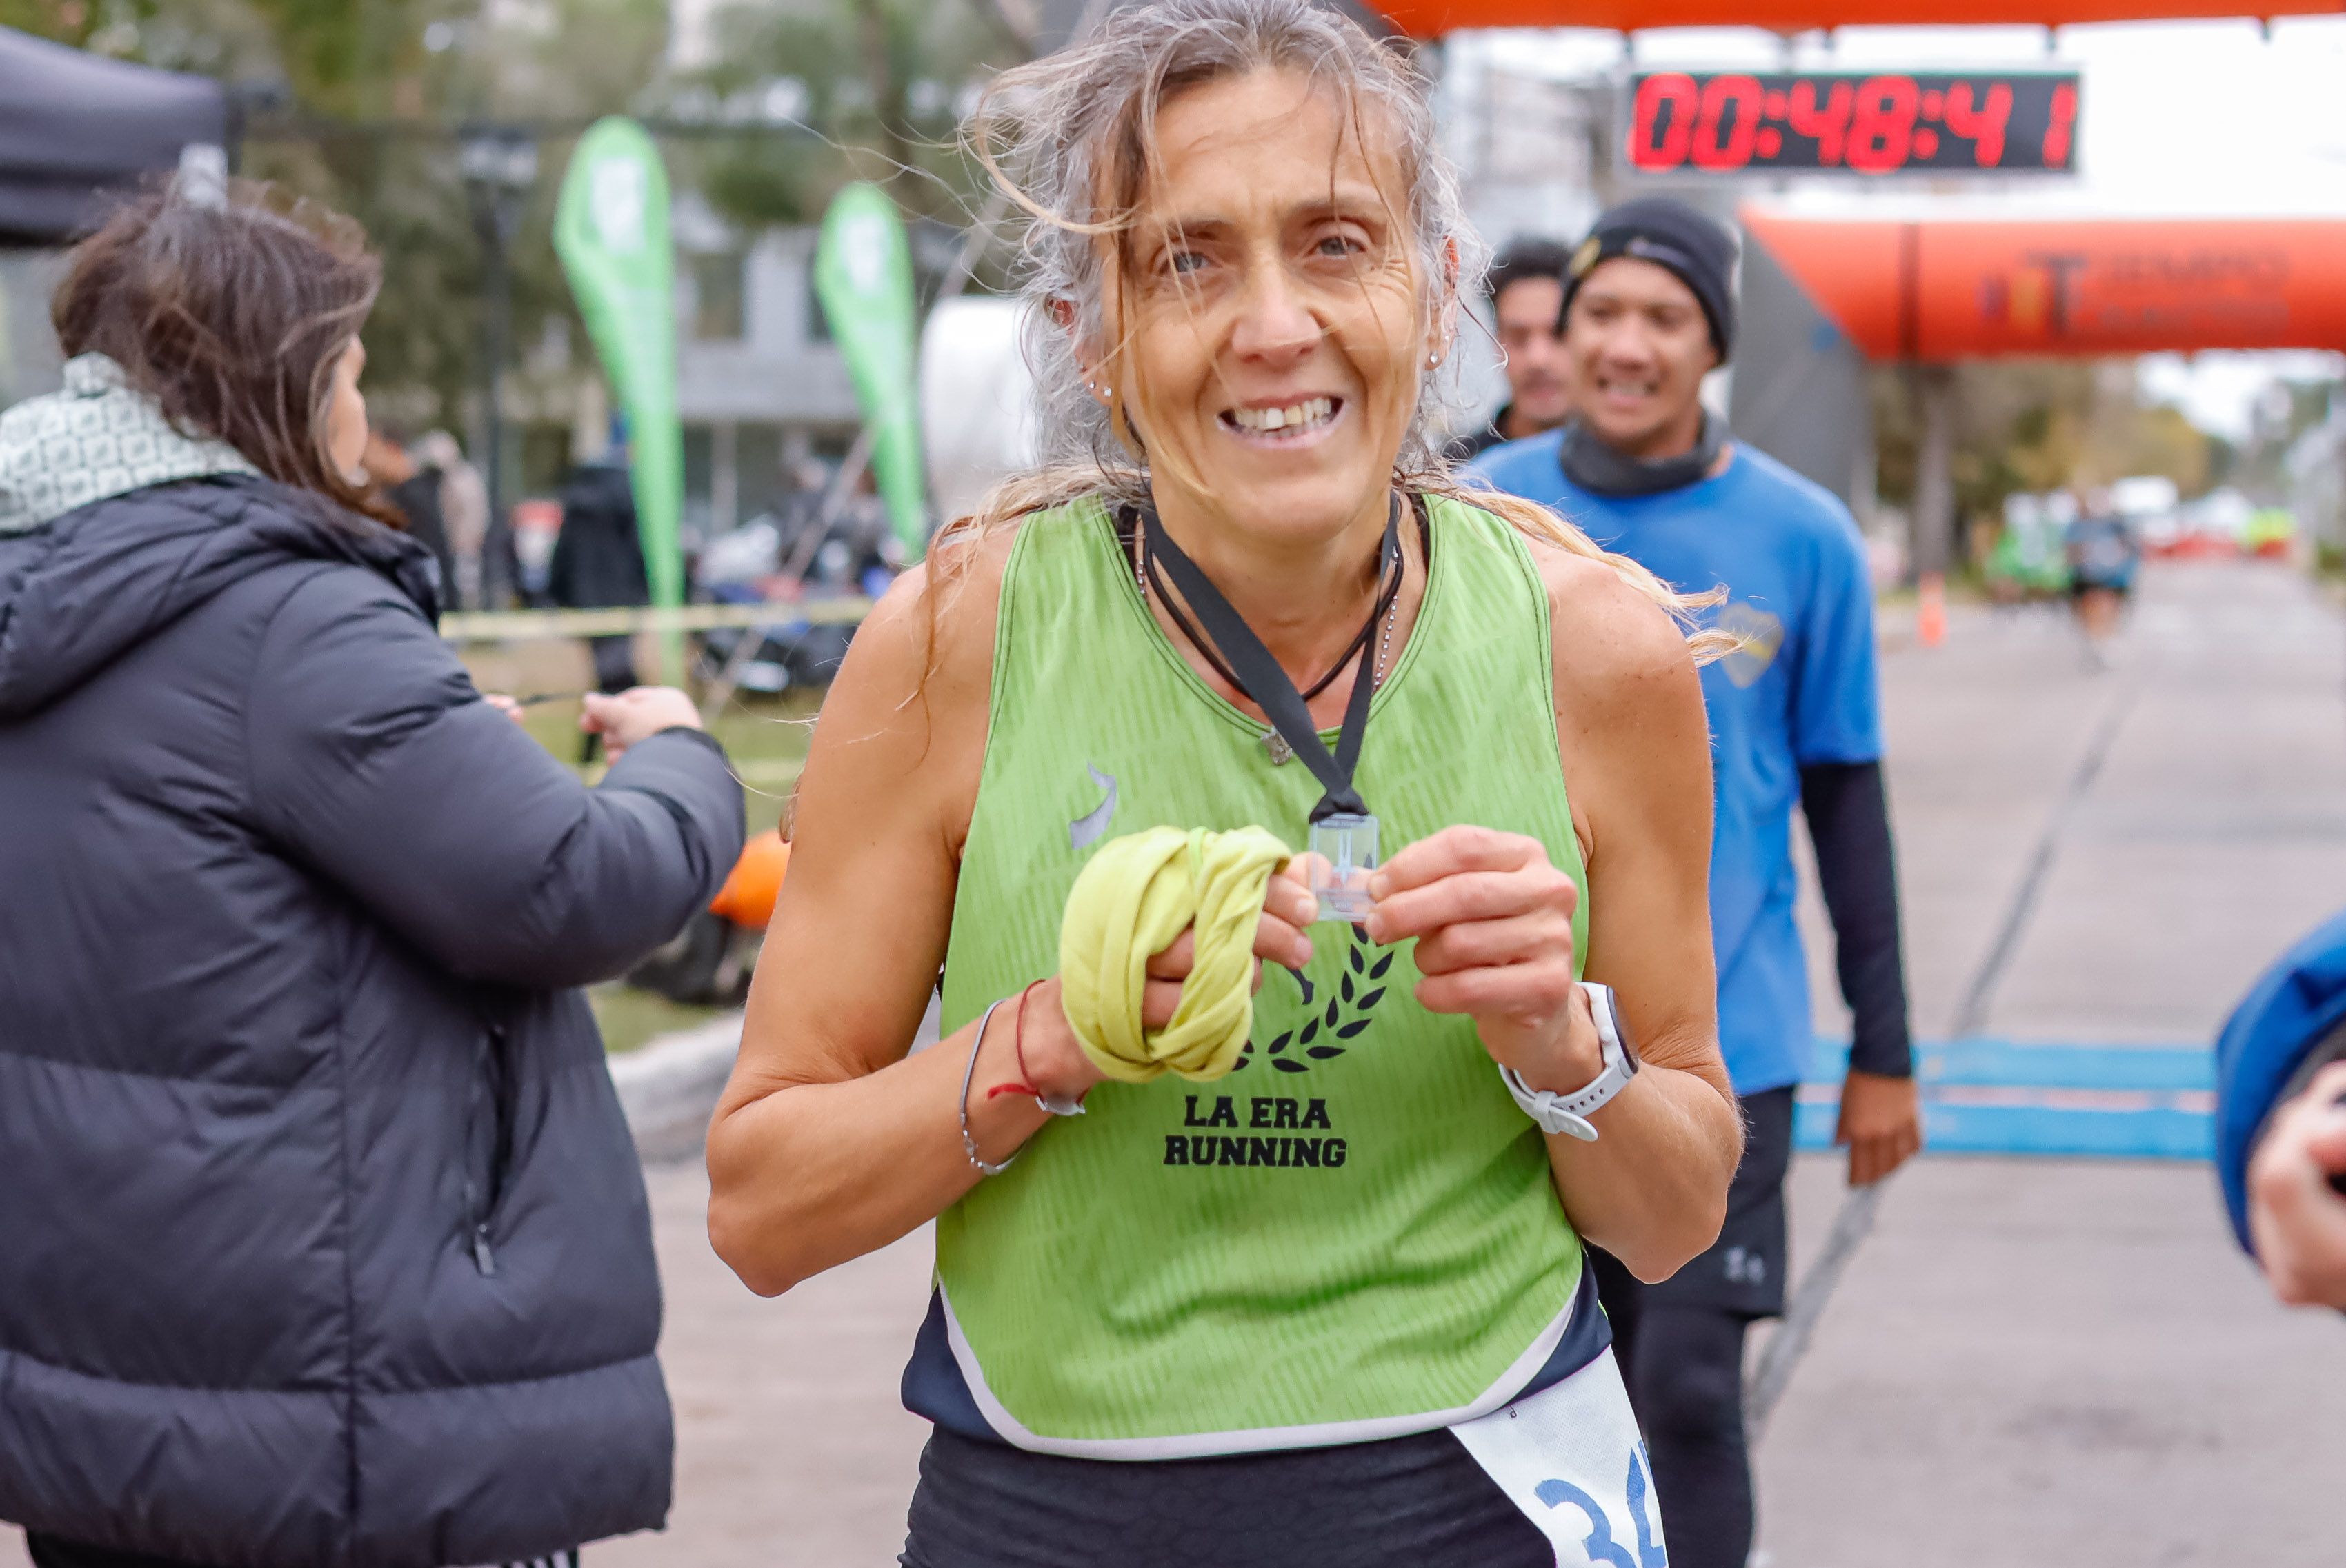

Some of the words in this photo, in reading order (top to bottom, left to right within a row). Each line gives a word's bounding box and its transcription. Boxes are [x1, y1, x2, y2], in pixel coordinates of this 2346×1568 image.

[1627, 73, 2076, 174] 00:48:41
[1184, 1095, 1239, 1128] LA
[1249, 1097, 1331, 1129] ERA
[1164, 1135, 1347, 1168] RUNNING
